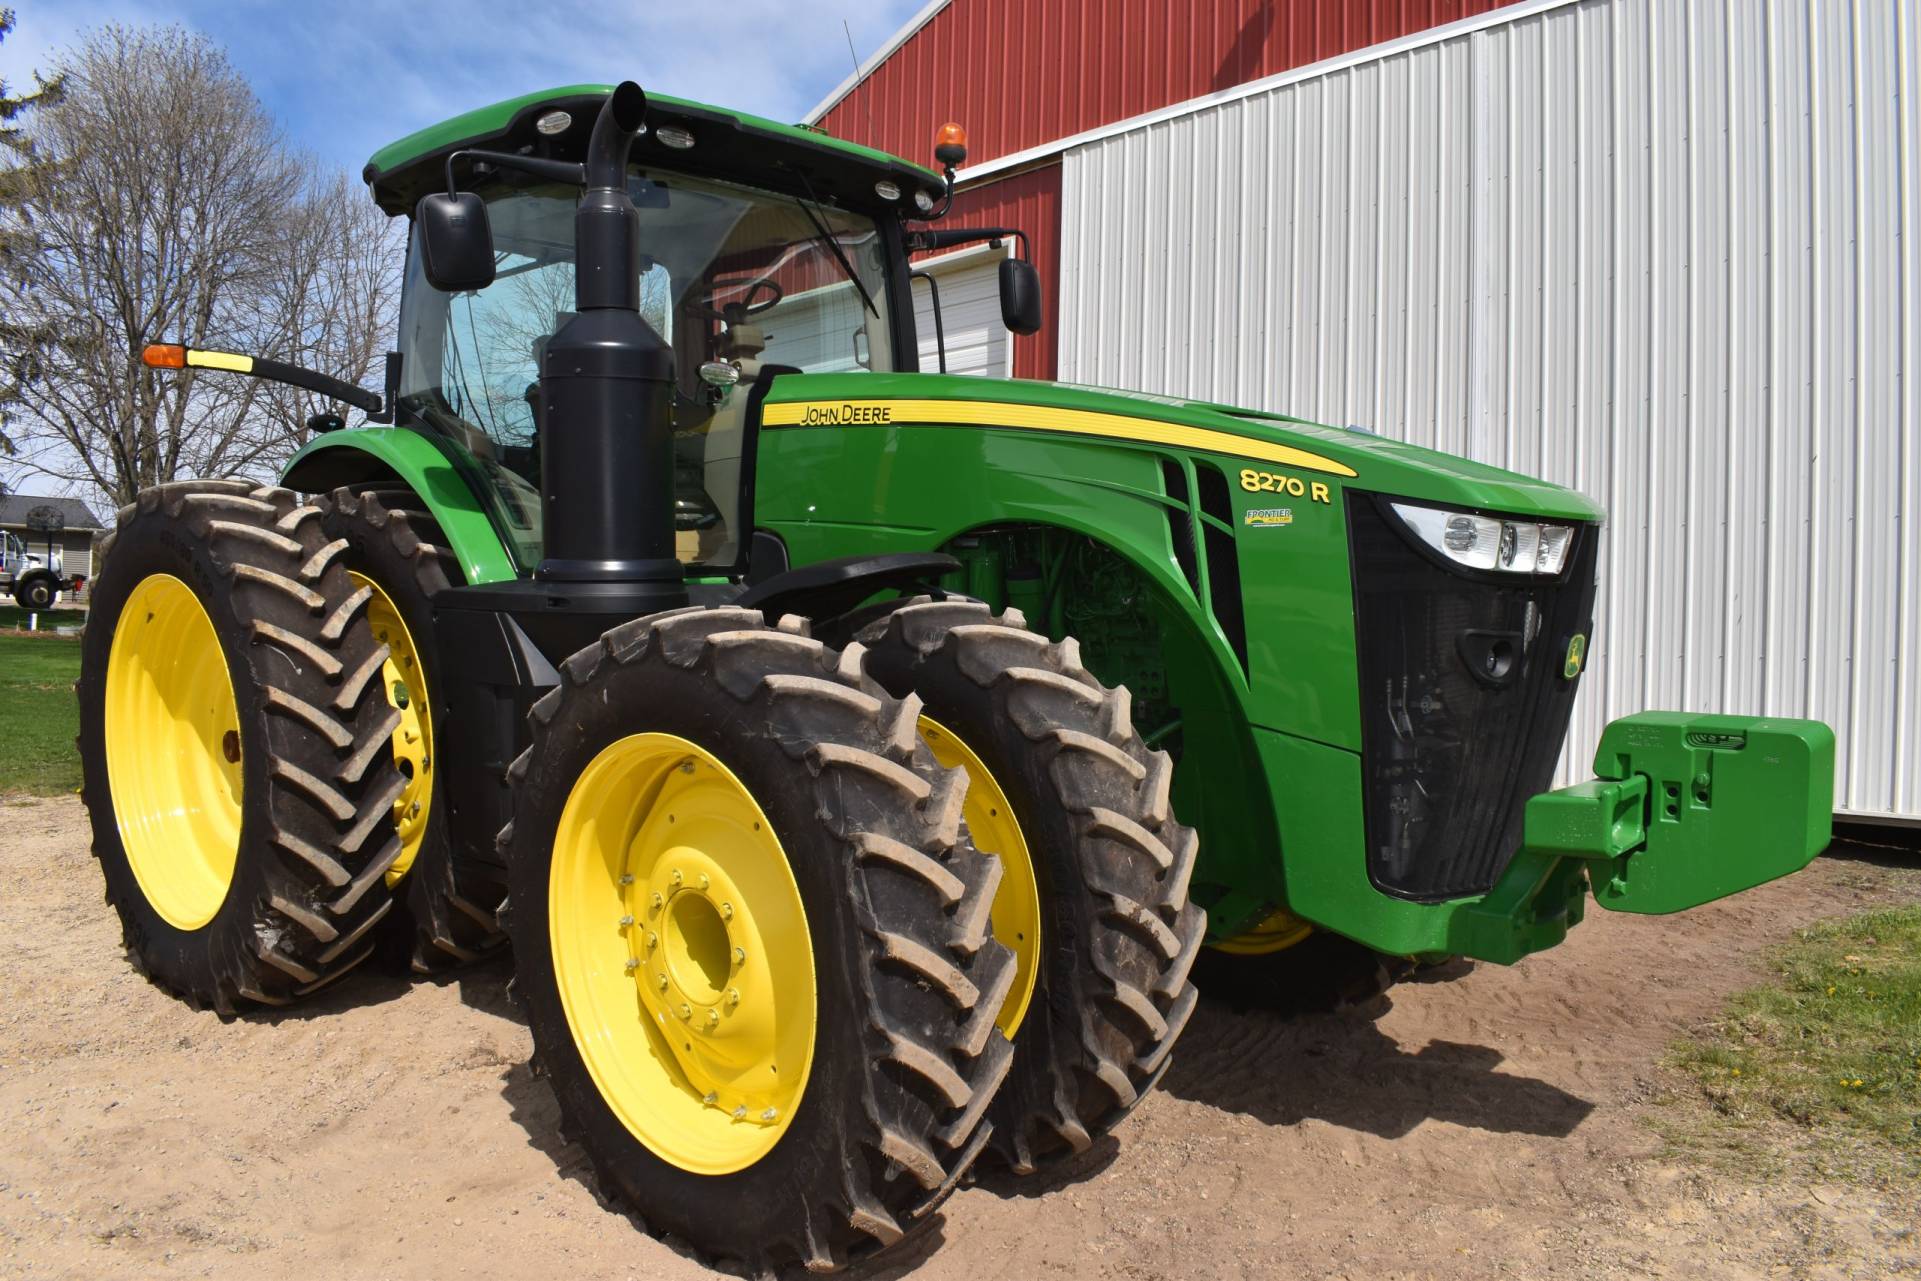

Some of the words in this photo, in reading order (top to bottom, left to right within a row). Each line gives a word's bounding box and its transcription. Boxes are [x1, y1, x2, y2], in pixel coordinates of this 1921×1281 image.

[801, 405, 838, 423] JOHN
[842, 404, 891, 422] DEERE
[1240, 469, 1305, 497] 8270
[1311, 481, 1330, 504] R
[1247, 509, 1291, 518] FRONTIER
